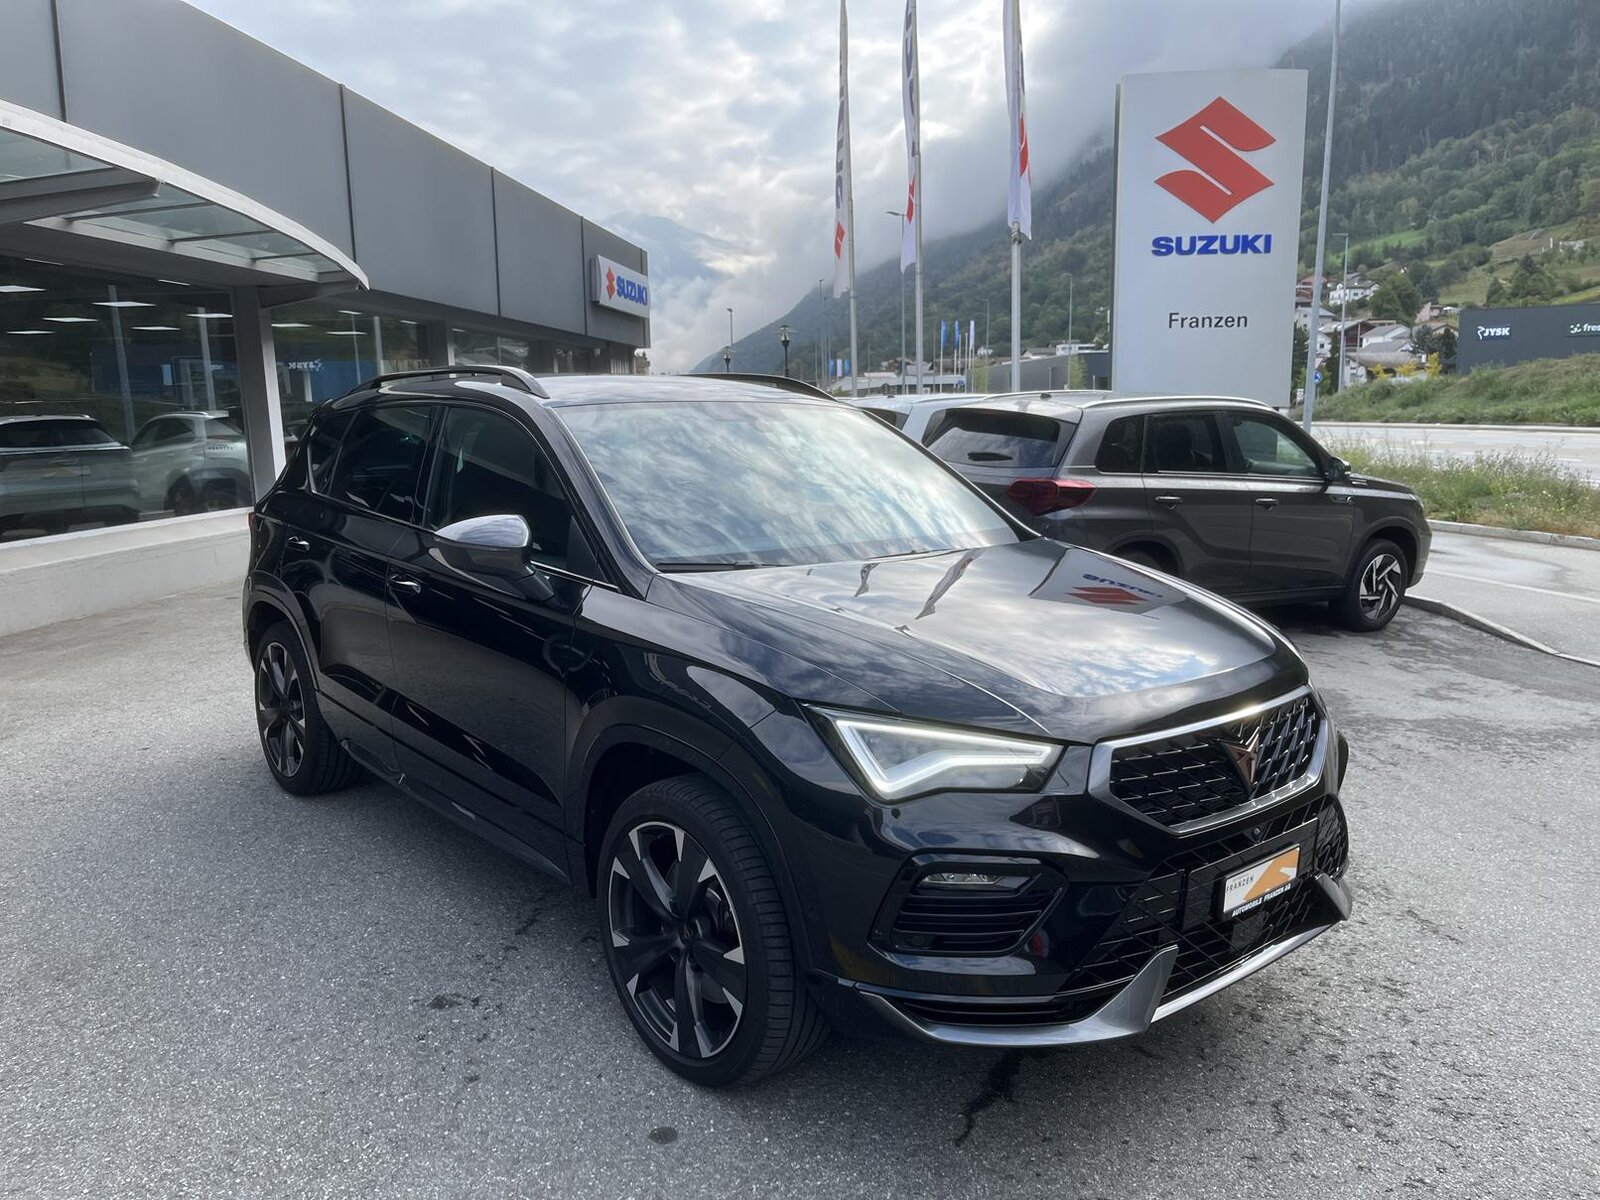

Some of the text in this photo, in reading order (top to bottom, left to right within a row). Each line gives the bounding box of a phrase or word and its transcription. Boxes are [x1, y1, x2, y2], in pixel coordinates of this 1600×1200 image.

[1151, 234, 1272, 257] SUZUKI
[616, 275, 648, 306] SUZUKI
[1168, 312, 1248, 329] Franzen
[1483, 327, 1511, 337] JYSK
[1226, 875, 1255, 892] FRANZEN
